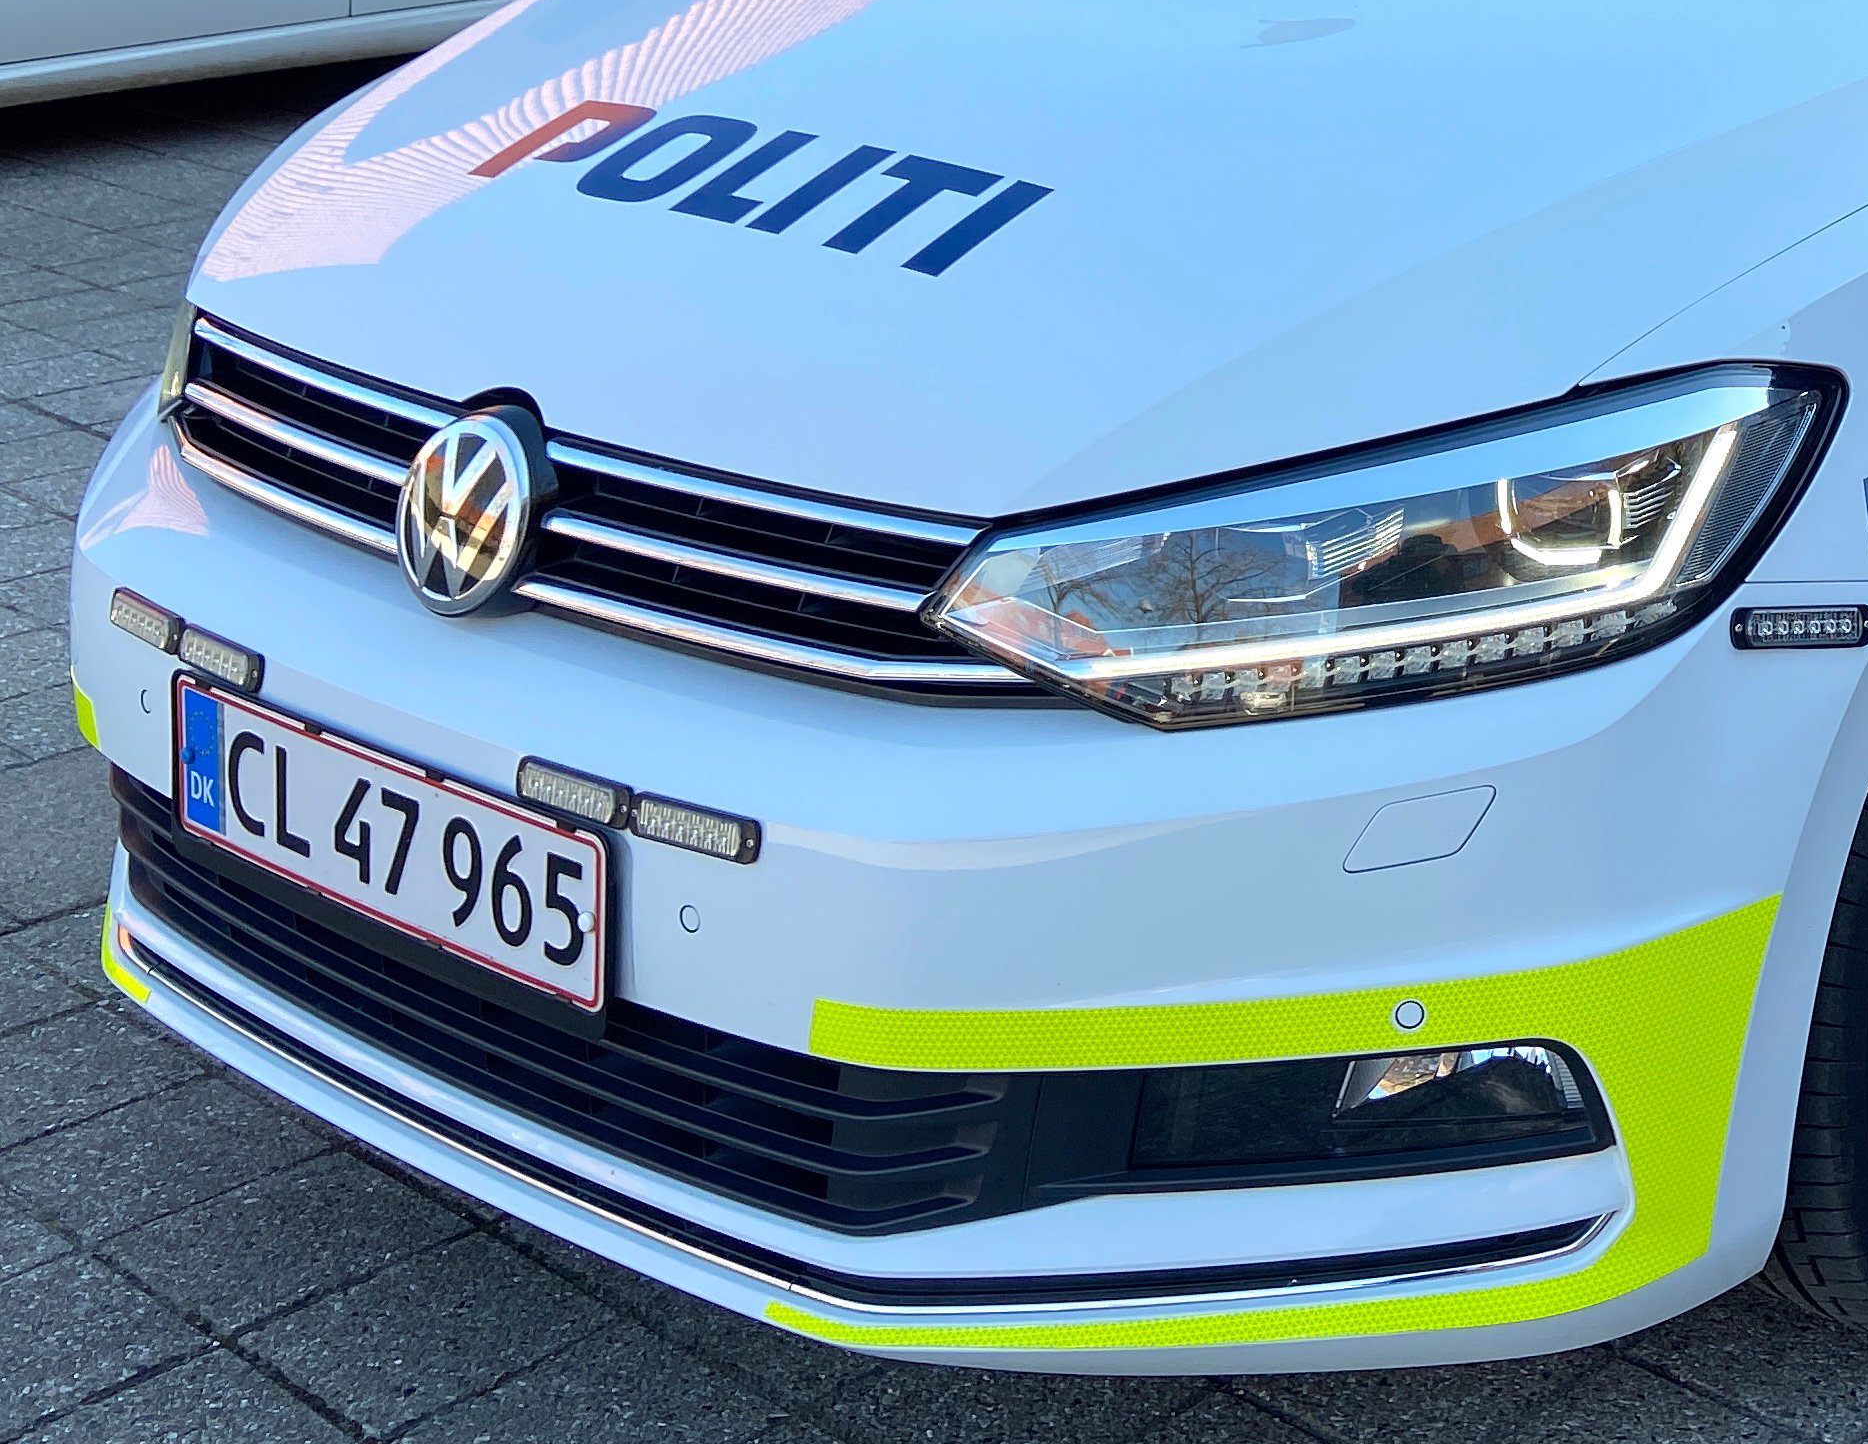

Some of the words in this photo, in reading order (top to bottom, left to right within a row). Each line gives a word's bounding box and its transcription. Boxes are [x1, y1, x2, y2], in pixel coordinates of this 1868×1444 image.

[467, 99, 1055, 278] POLITI
[189, 770, 215, 808] DK
[228, 730, 311, 857] CL
[333, 778, 420, 894] 47
[442, 816, 585, 966] 965
